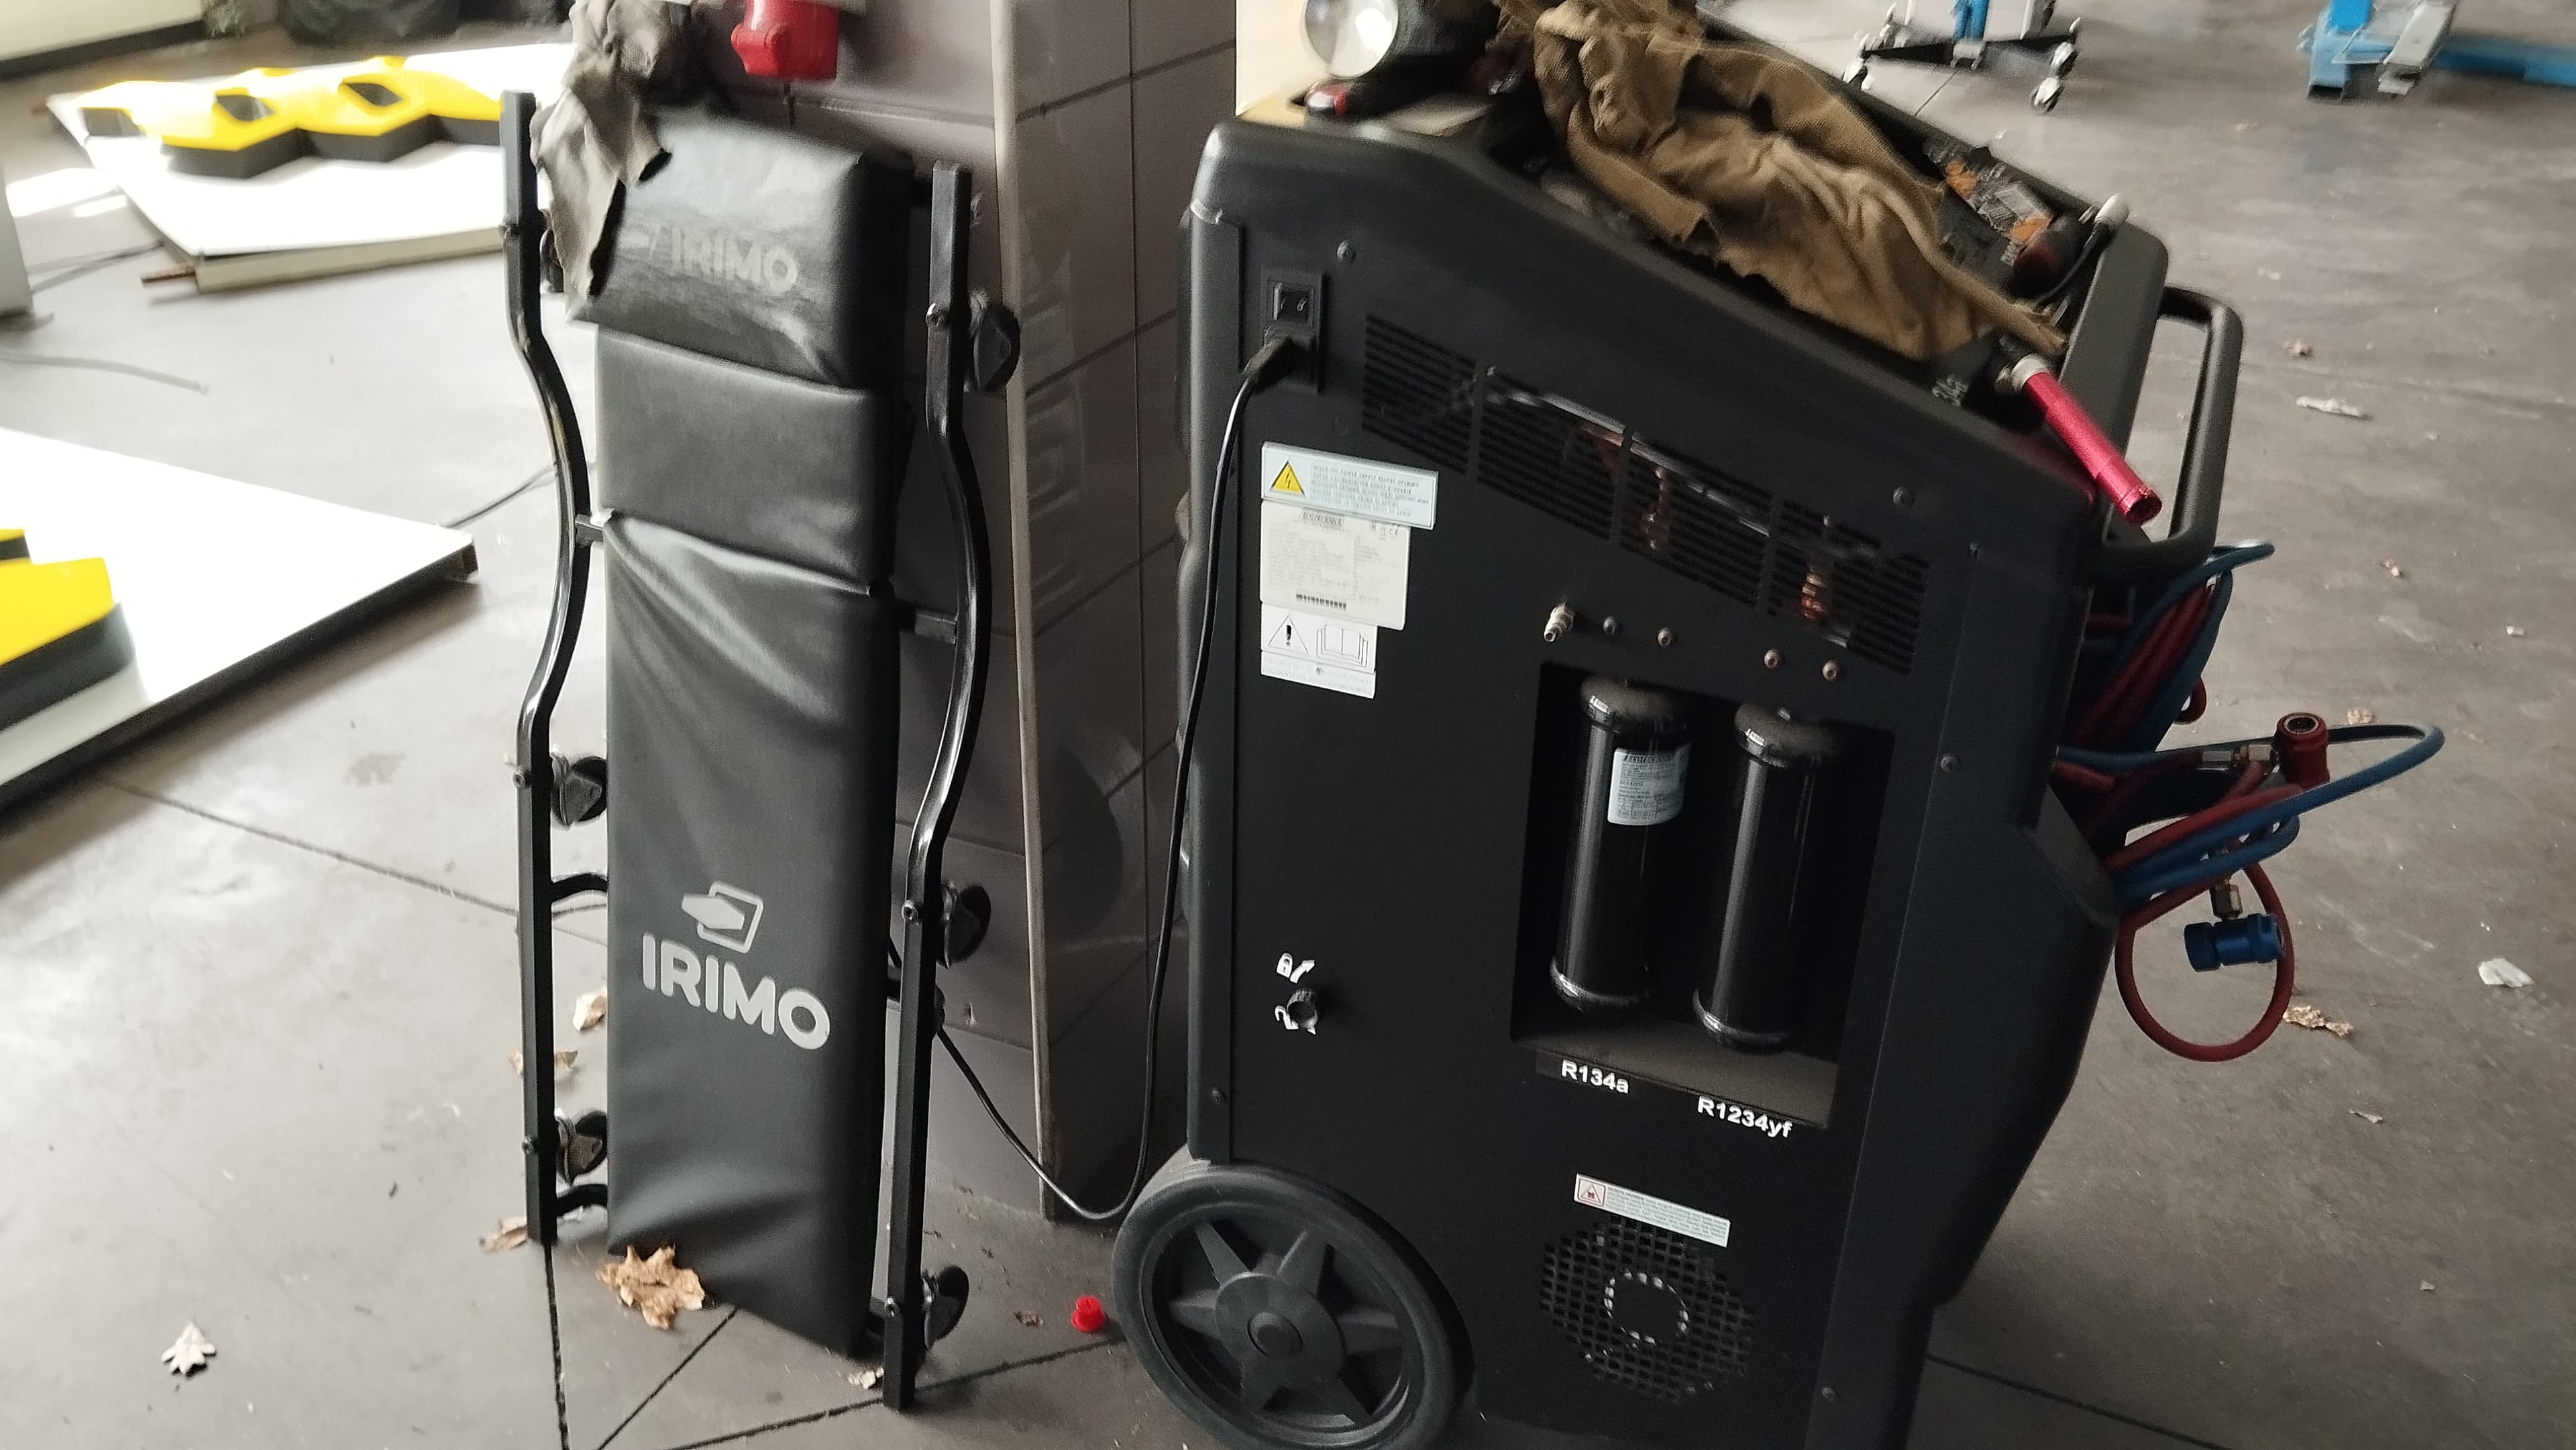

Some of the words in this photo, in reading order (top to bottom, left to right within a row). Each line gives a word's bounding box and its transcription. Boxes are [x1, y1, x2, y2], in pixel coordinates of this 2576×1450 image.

[672, 223, 798, 291] IRIMO
[643, 933, 830, 1049] IRIMO
[1562, 1059, 1629, 1094] R134a
[1698, 1095, 1793, 1138] R1234yf
